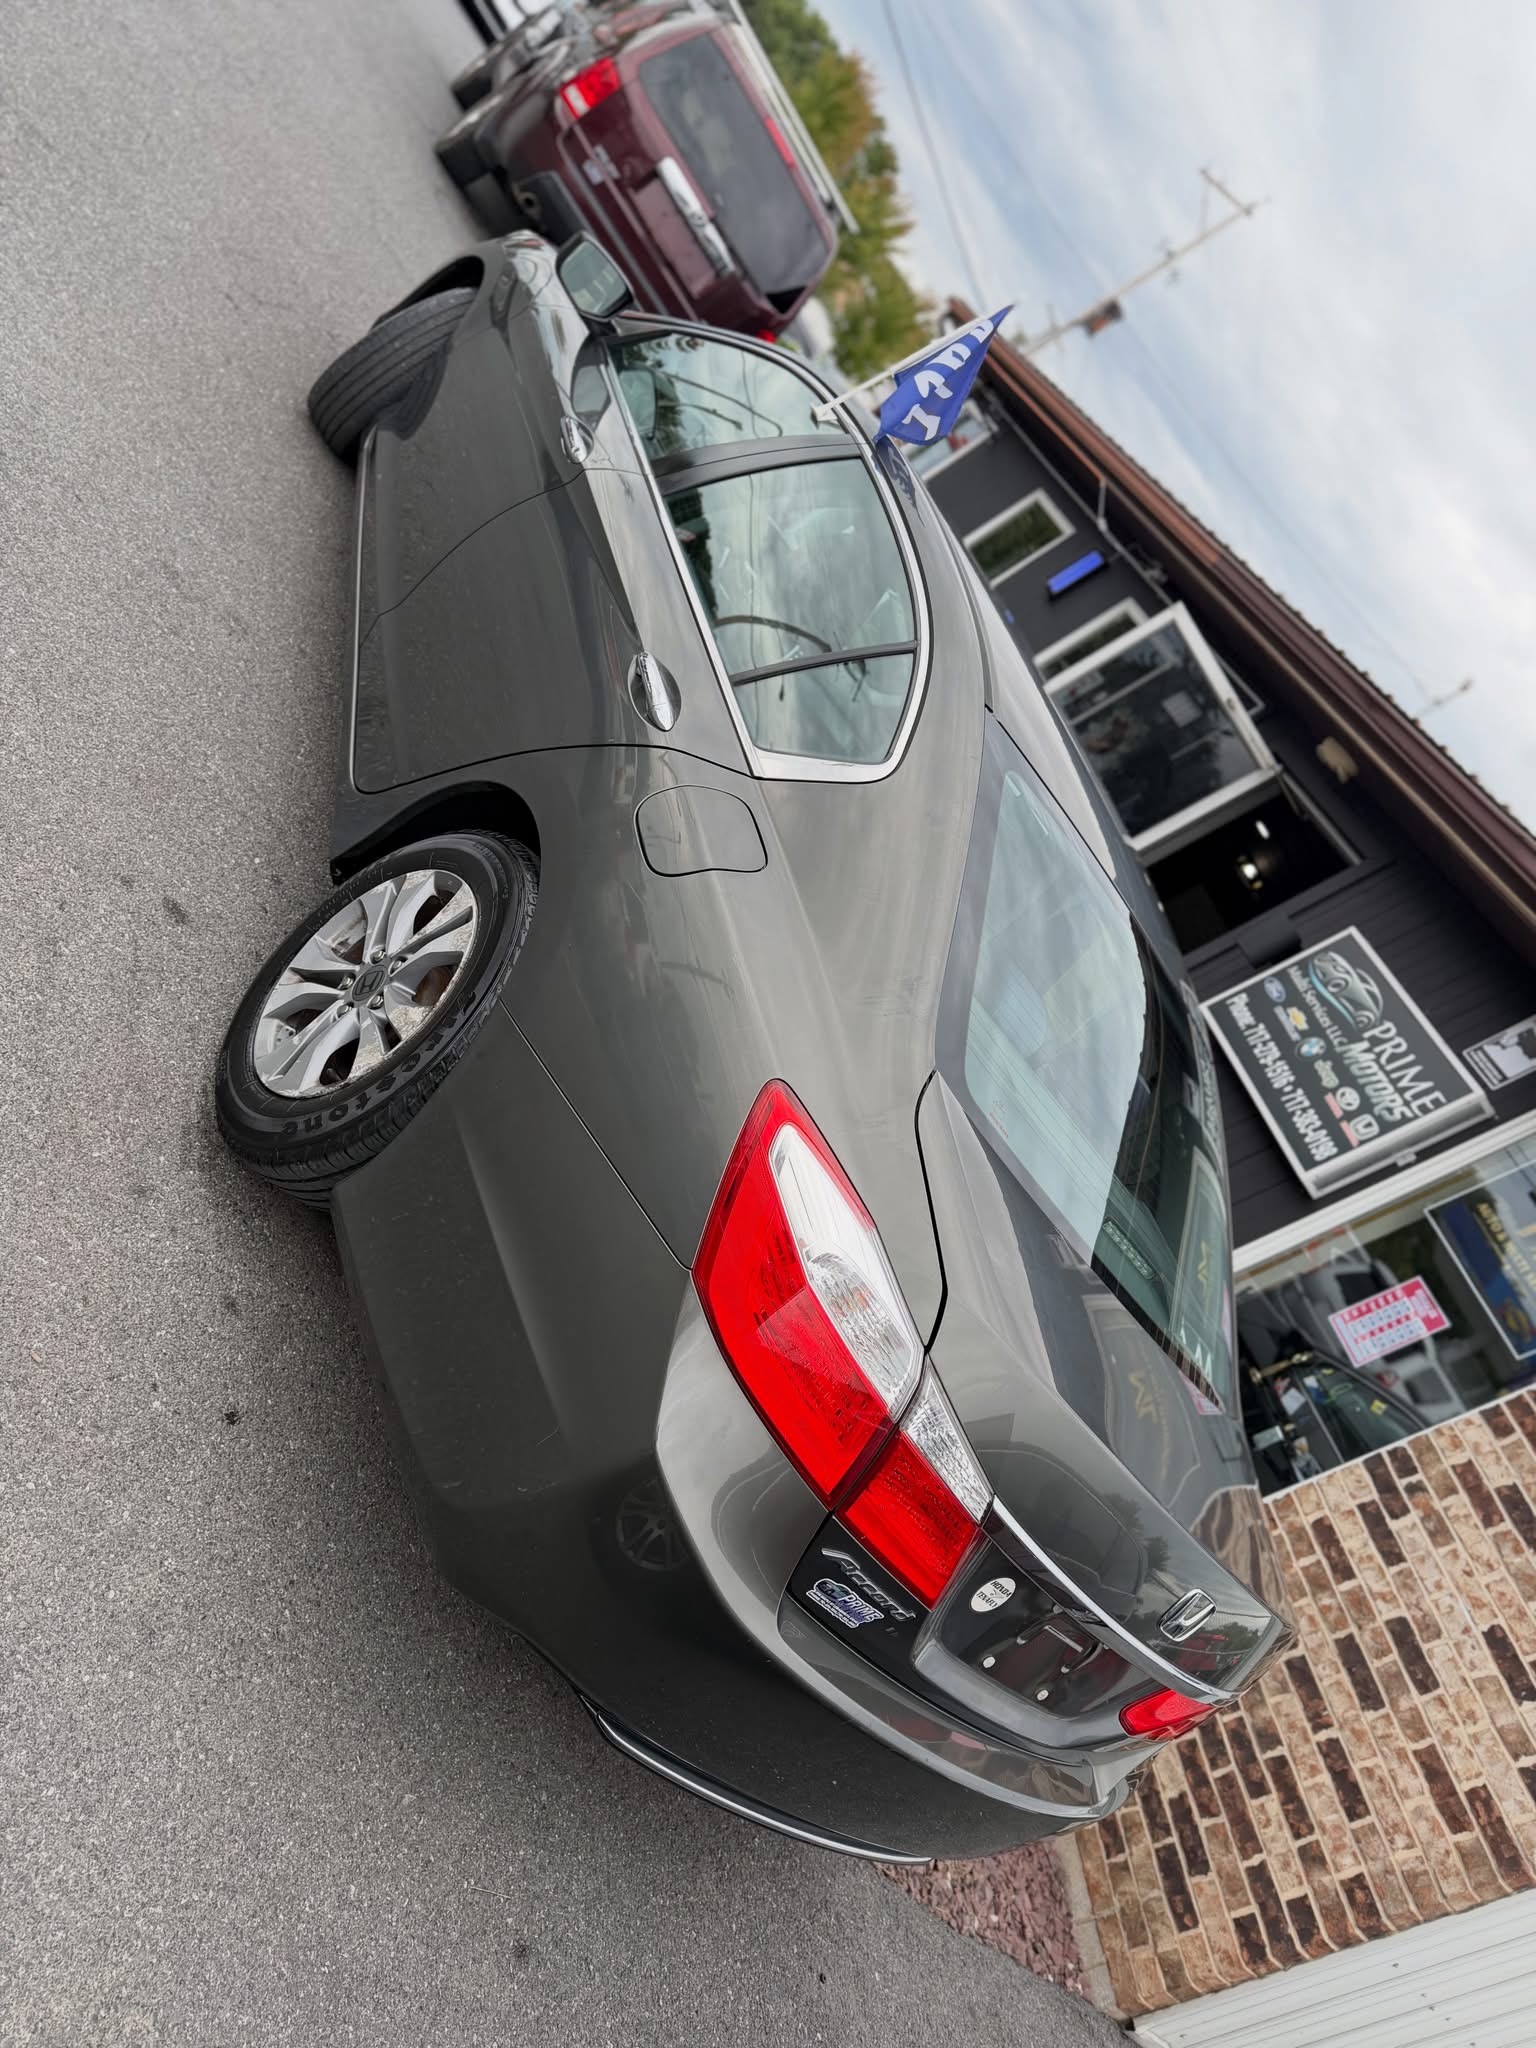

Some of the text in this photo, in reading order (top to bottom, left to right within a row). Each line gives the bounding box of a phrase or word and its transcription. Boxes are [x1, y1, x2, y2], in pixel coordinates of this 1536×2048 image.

[1304, 989, 1333, 1027] Services
[1325, 1024, 1346, 1047] LLC
[1335, 1041, 1414, 1123] MOTORS
[1362, 1020, 1446, 1119] PRIME
[822, 1549, 915, 1621] Accord
[839, 1594, 880, 1621] PRIME
[976, 1590, 998, 1608] TENAFLY
[990, 1580, 1012, 1597] HONDA
